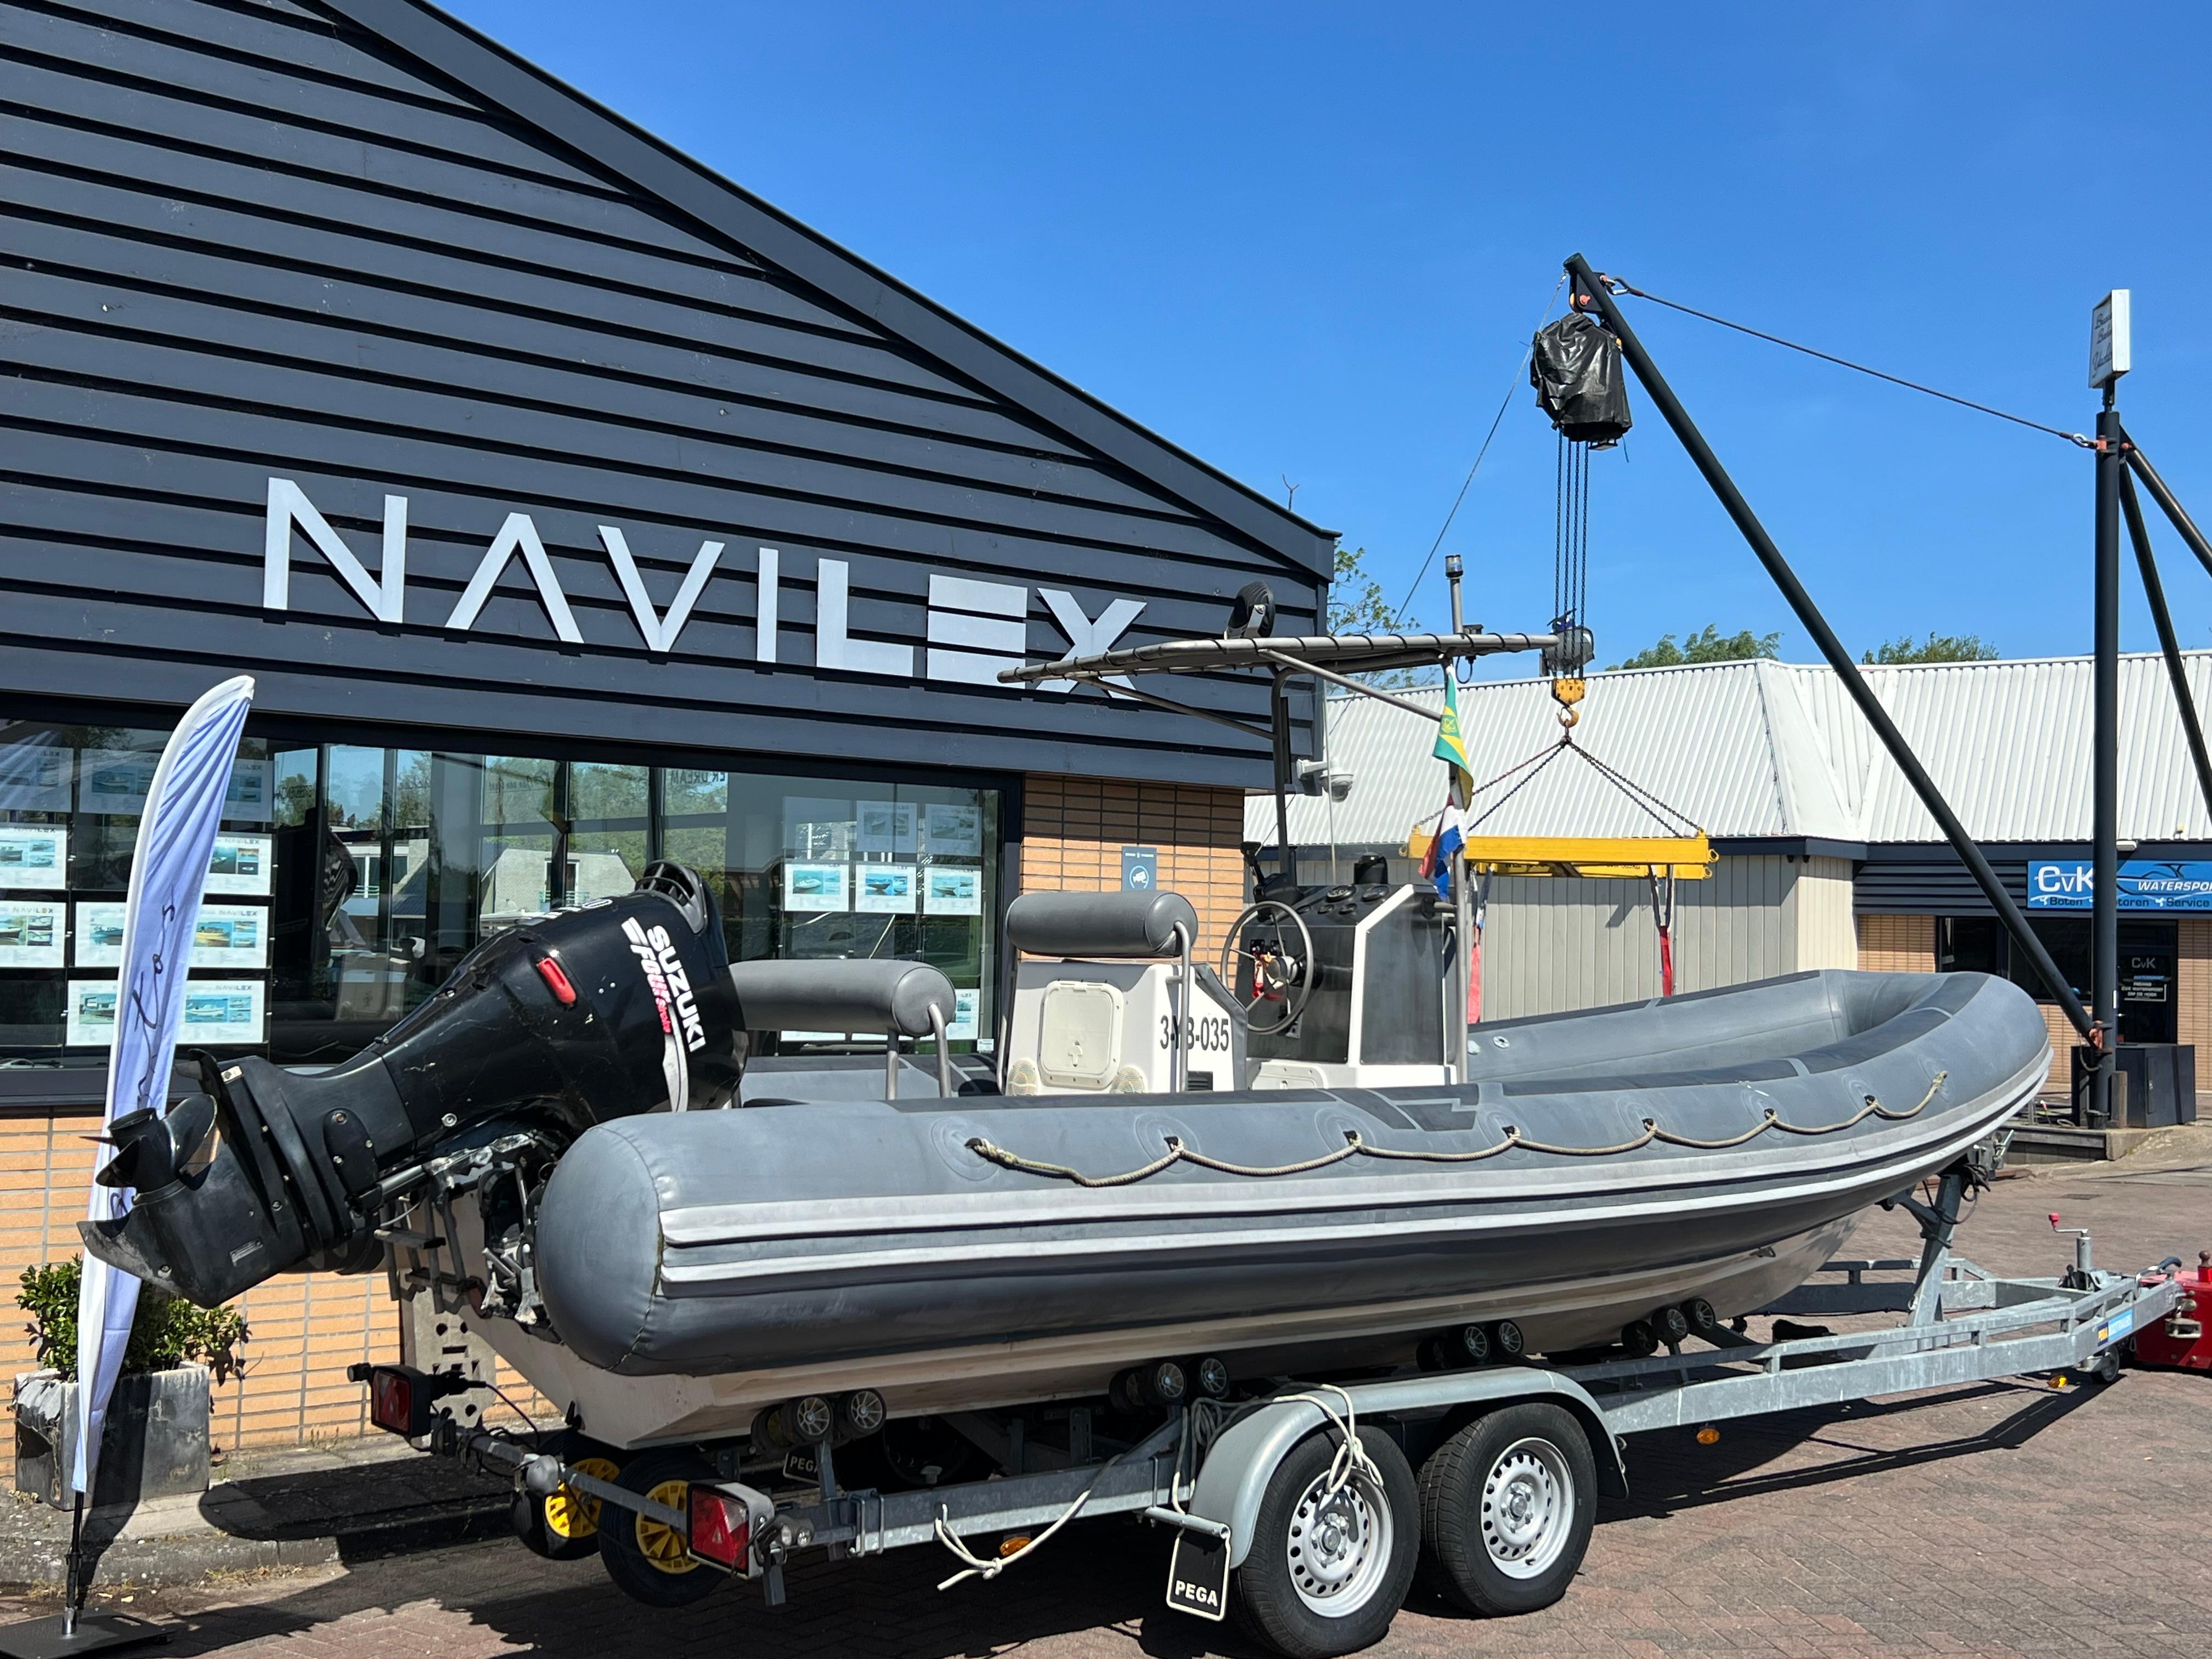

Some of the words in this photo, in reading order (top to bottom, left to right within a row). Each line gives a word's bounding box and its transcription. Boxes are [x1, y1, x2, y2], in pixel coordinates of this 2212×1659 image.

[263, 476, 1147, 701] NAVILEX
[2038, 865, 2094, 893] CvK
[2050, 896, 2083, 906] Boten
[2166, 897, 2210, 907] Service
[2131, 957, 2156, 969] CvK
[647, 925, 707, 1053] SUZUKI
[1175, 1579, 1218, 1607] PEGA
